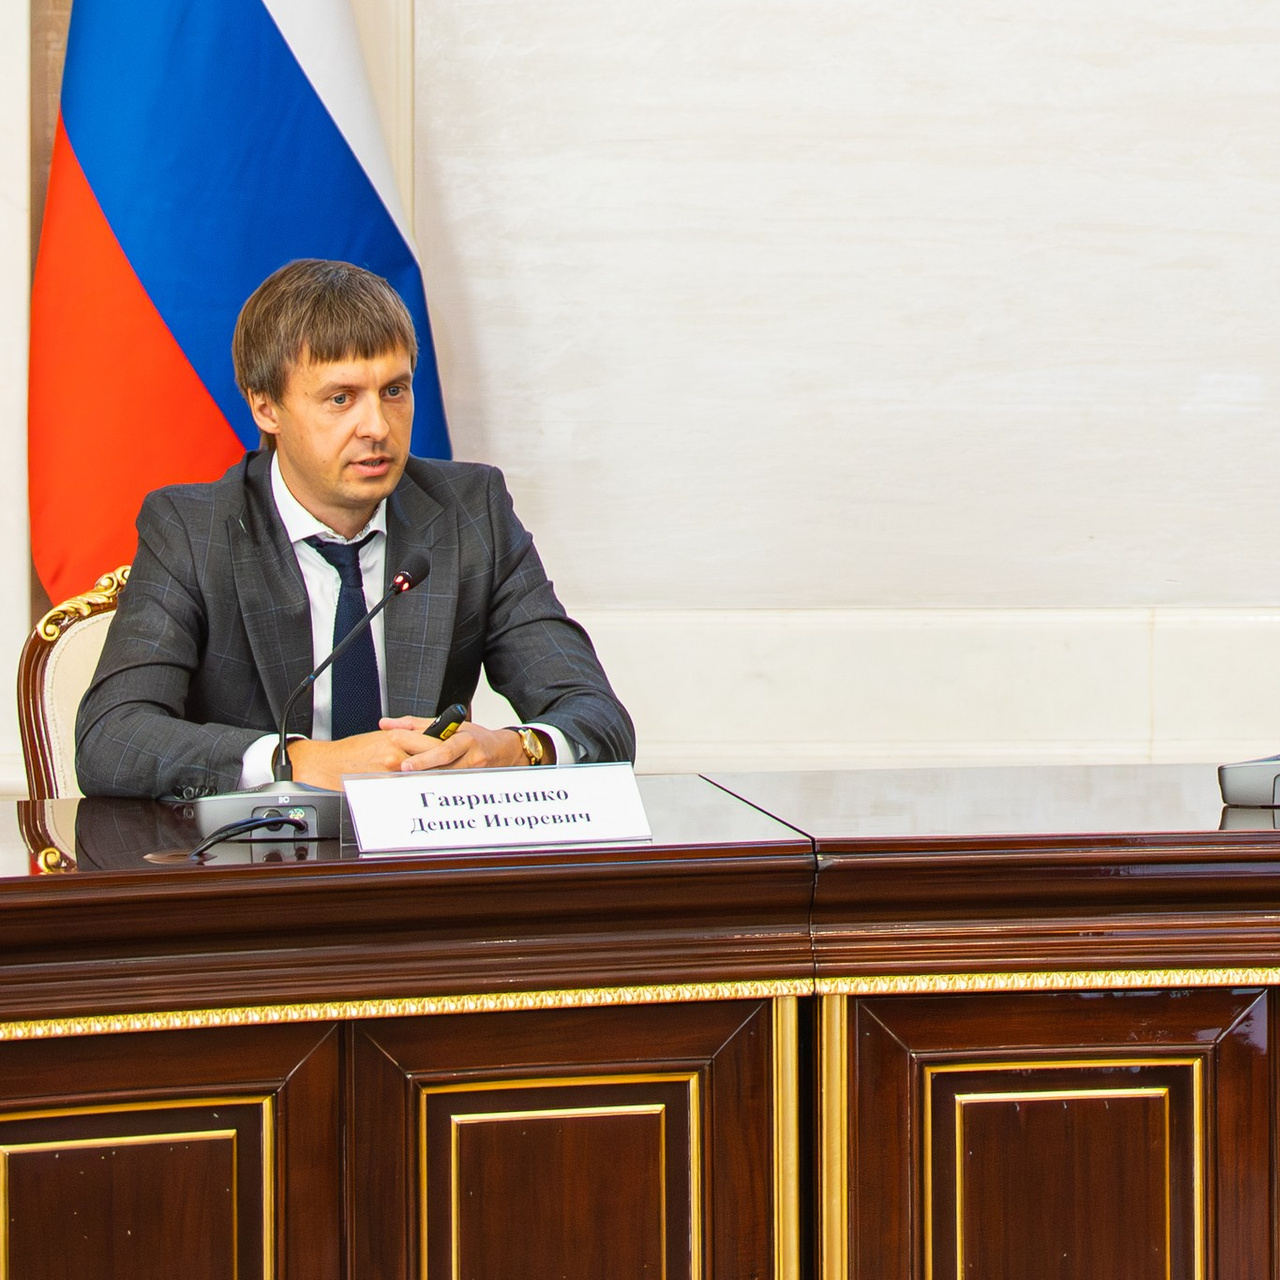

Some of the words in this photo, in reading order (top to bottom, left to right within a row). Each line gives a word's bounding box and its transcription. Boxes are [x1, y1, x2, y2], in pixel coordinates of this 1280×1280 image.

[419, 789, 569, 811] Гавриленко
[410, 817, 477, 835] Денис
[483, 812, 592, 830] Игоревич
